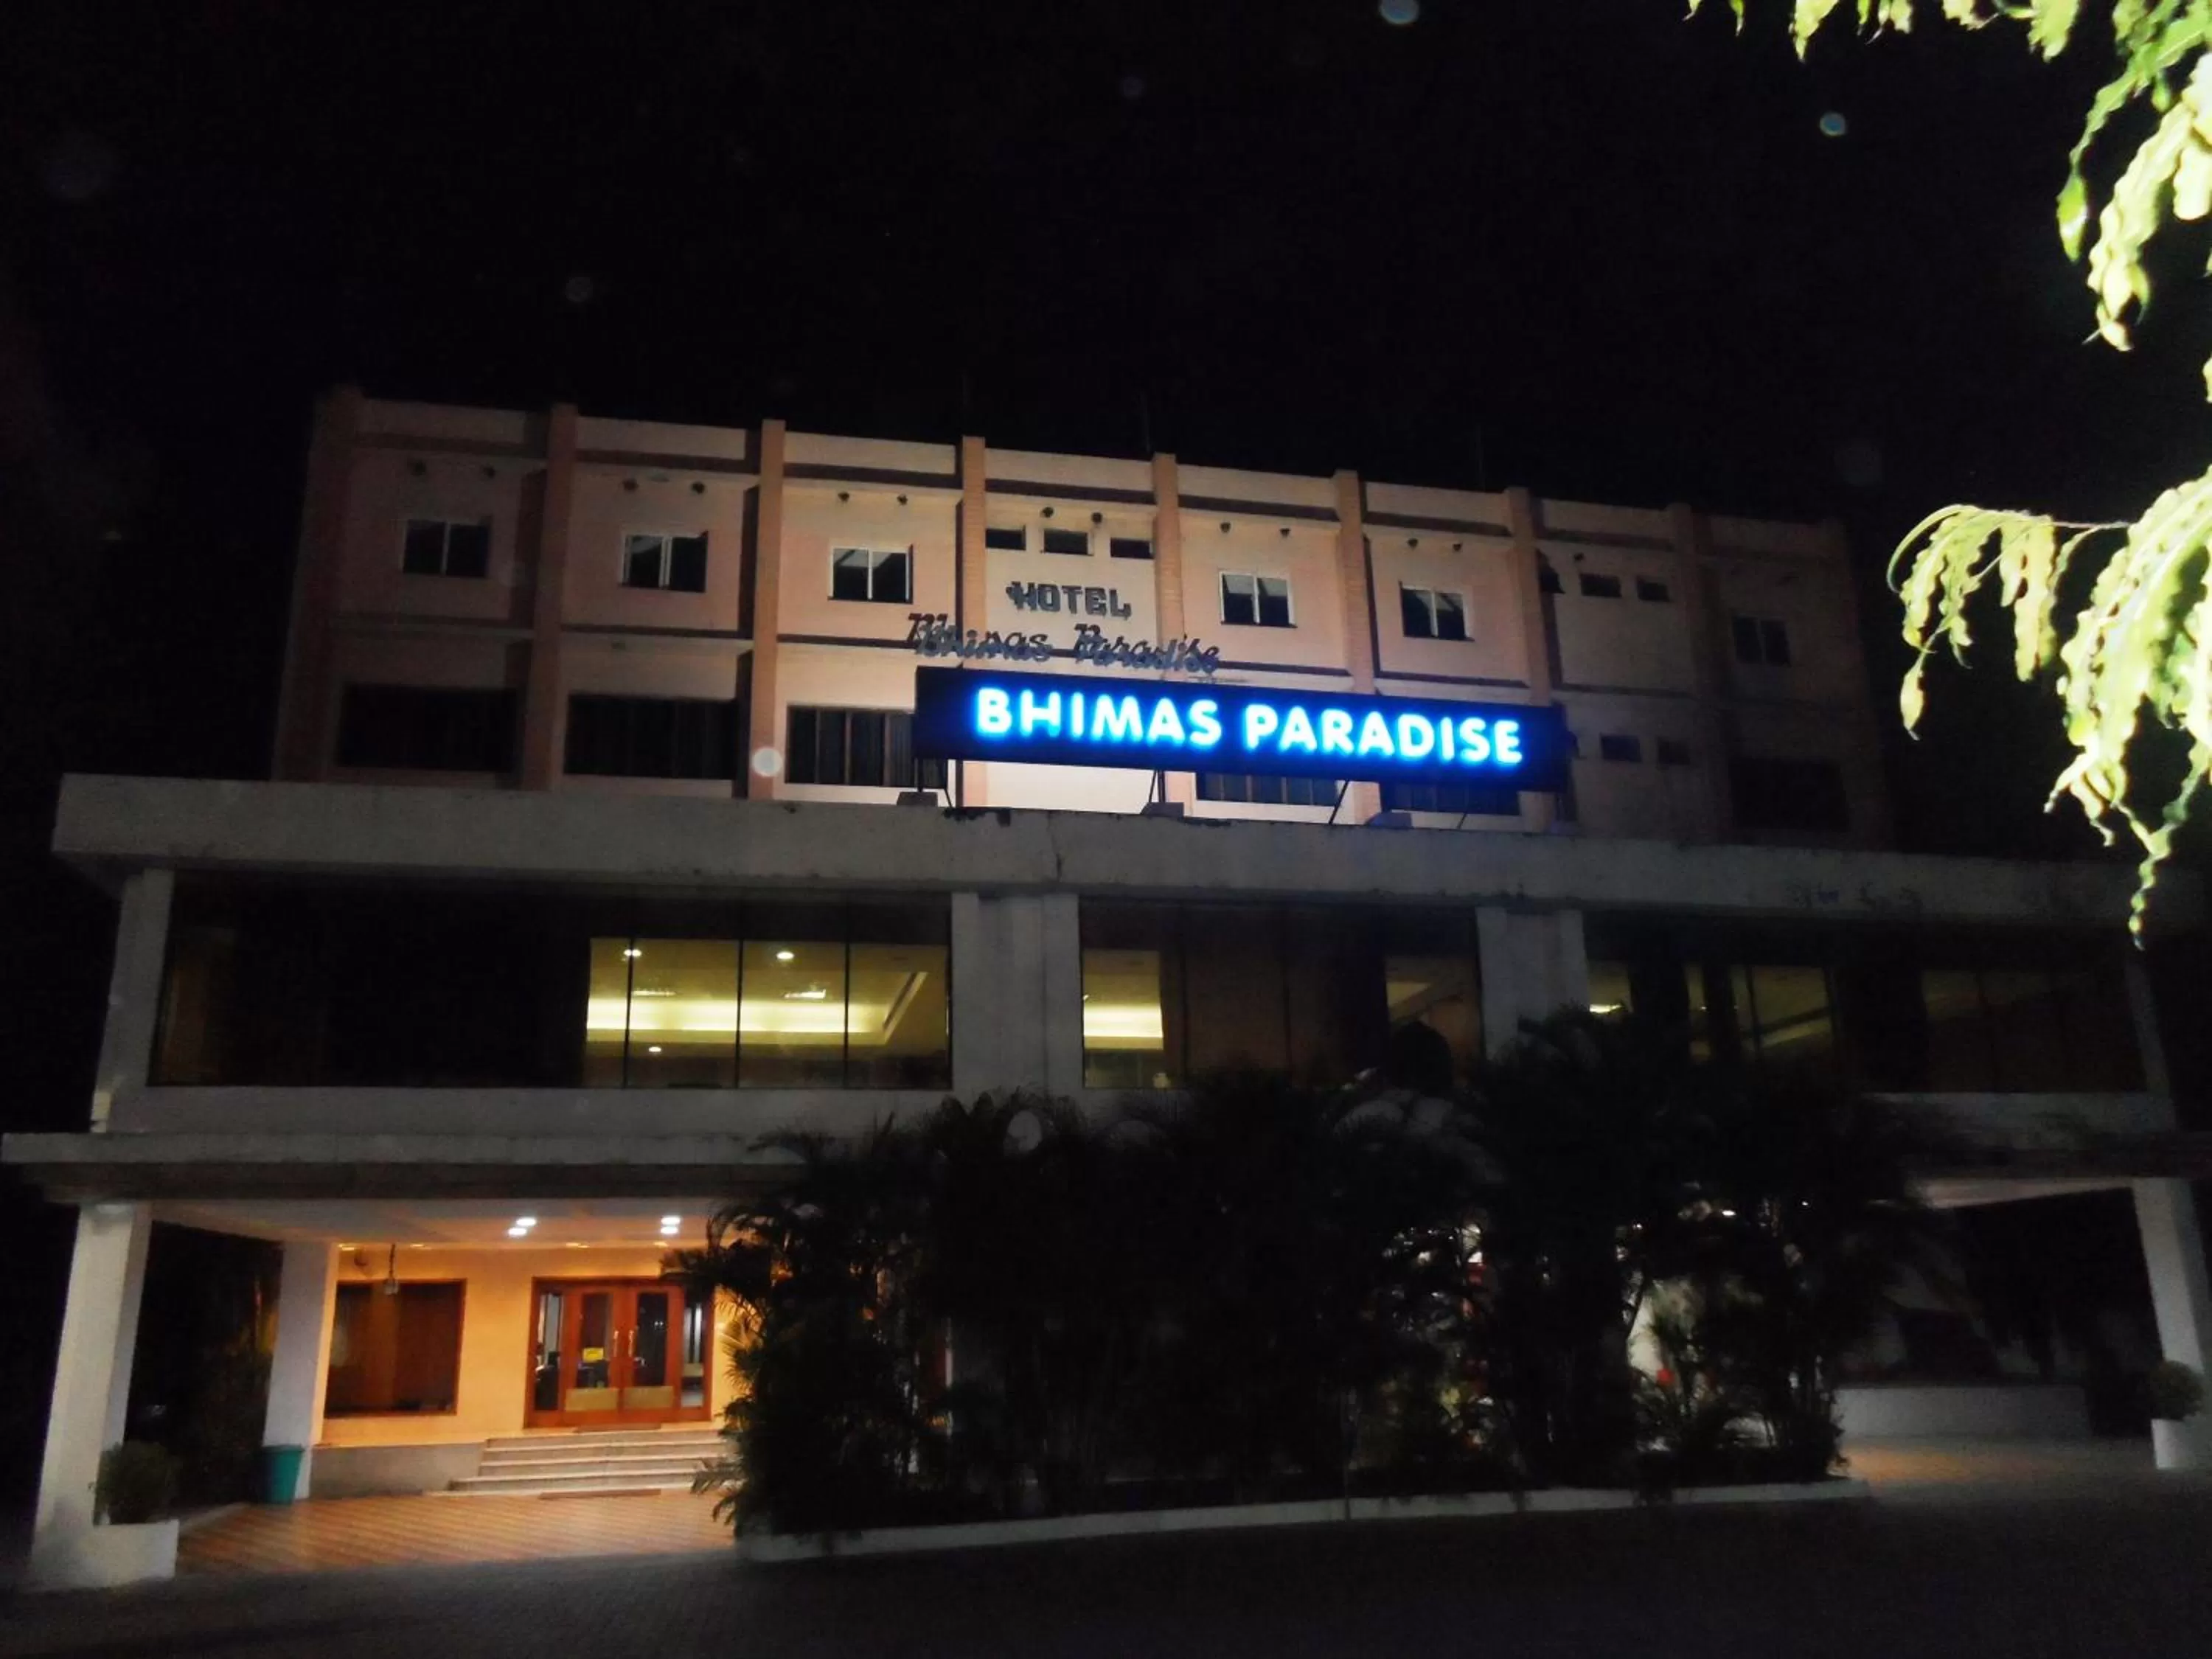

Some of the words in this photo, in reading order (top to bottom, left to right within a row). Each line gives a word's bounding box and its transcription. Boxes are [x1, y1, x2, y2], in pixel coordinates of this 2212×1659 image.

[1006, 581, 1131, 619] HOTEL
[909, 615, 1054, 661] Bhimas
[1074, 625, 1220, 674] Paradise
[975, 687, 1222, 748] BHIMAS
[1243, 703, 1524, 765] PARADISE
